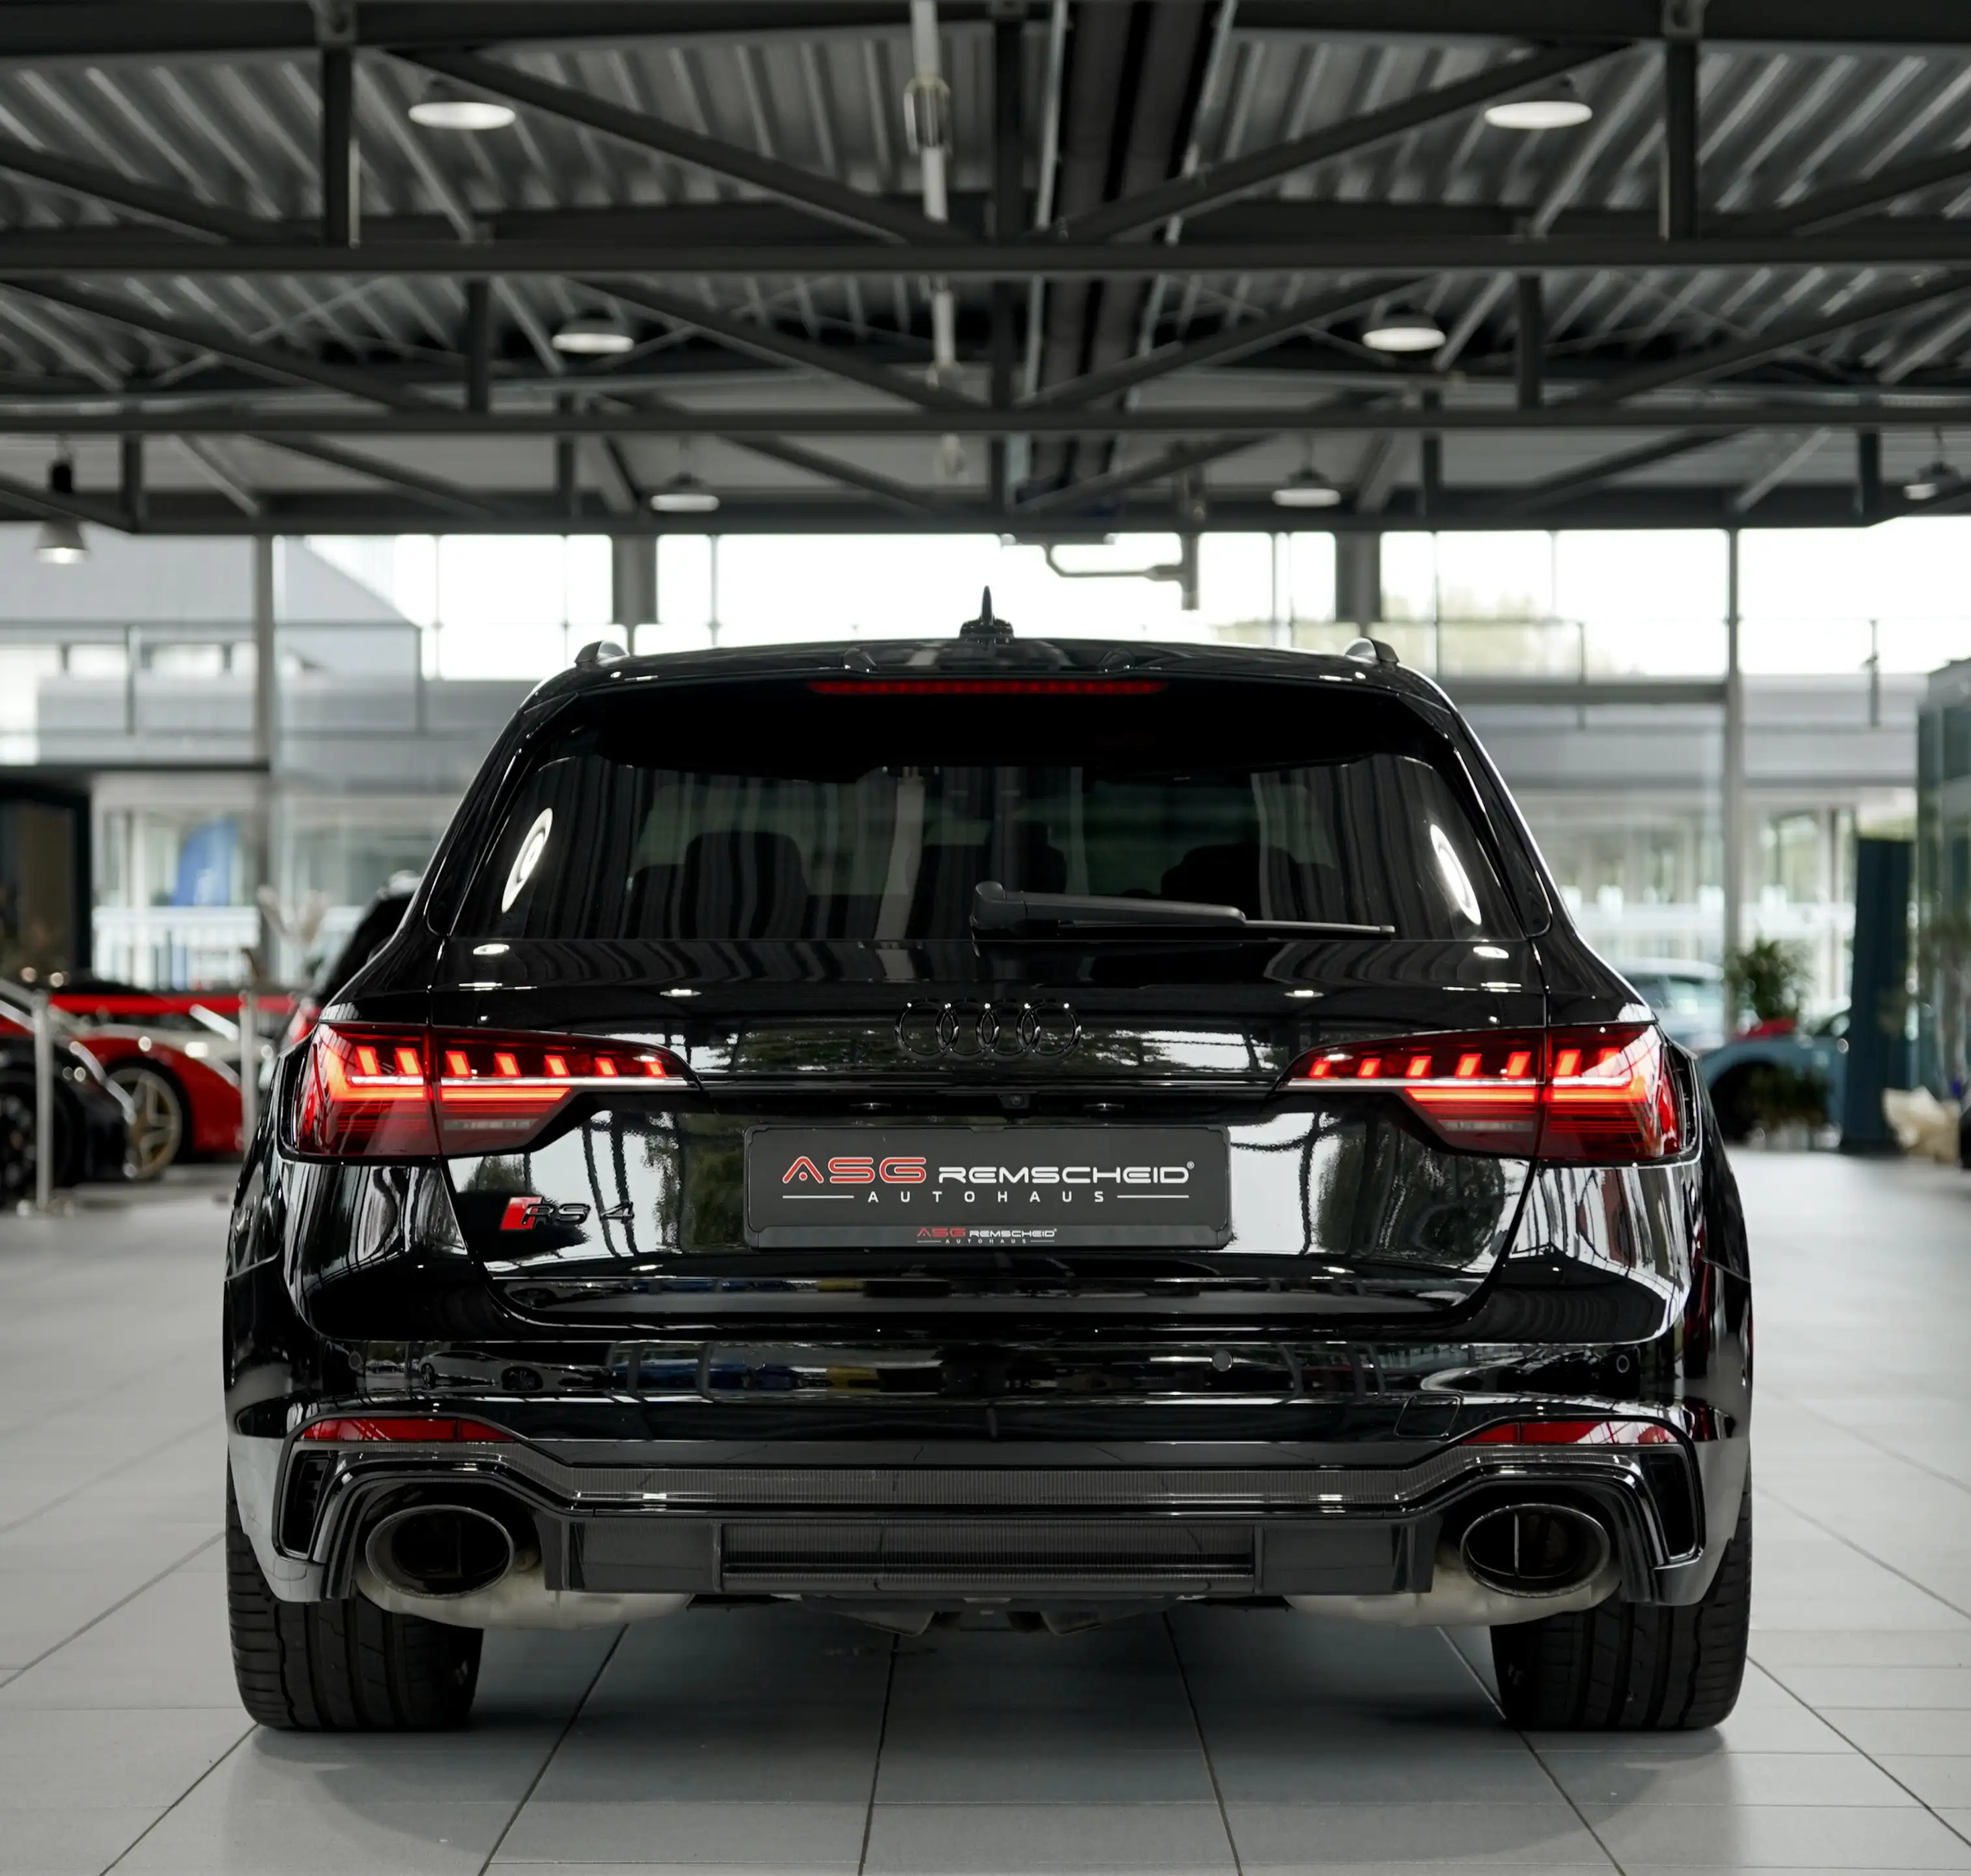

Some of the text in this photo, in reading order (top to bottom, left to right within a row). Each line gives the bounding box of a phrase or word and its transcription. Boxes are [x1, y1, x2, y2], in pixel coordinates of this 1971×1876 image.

[782, 1156, 927, 1184] ASG
[868, 1191, 1105, 1203] AUTOHAUS
[522, 1200, 636, 1226] RS 4
[916, 1228, 967, 1238] ASG
